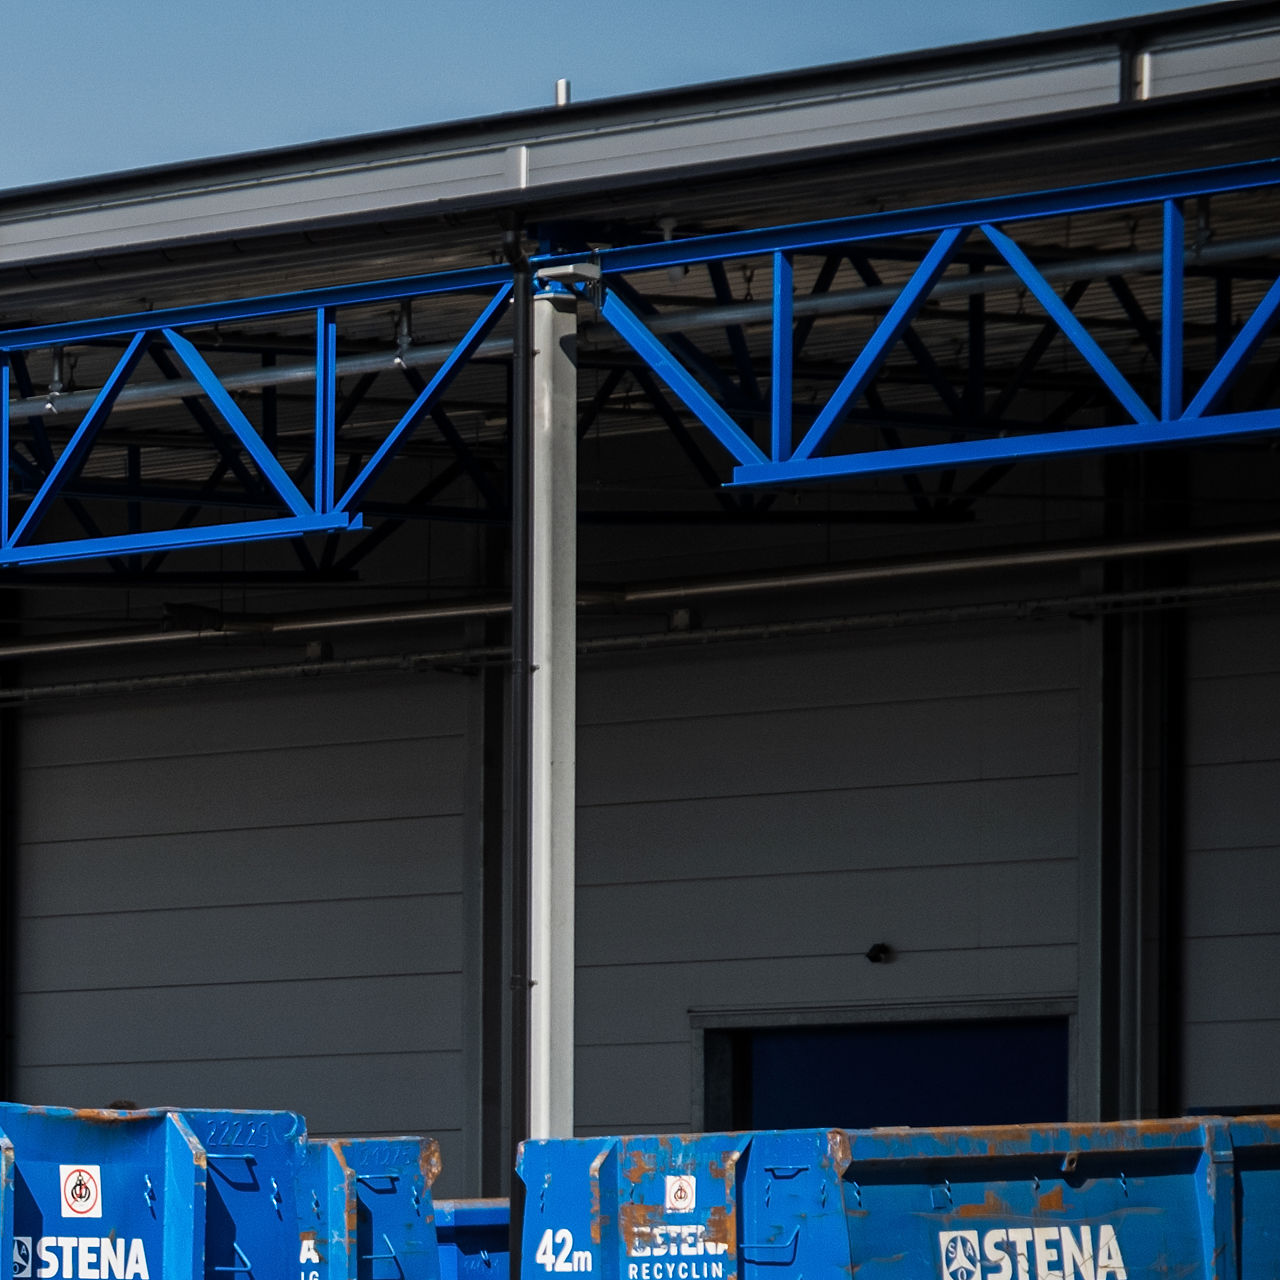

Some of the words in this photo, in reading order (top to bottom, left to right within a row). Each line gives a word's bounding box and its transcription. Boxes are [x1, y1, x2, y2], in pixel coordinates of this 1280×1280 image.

[36, 1236, 150, 1280] STENA
[535, 1228, 593, 1272] 42m
[628, 1261, 723, 1280] RECYCLIN
